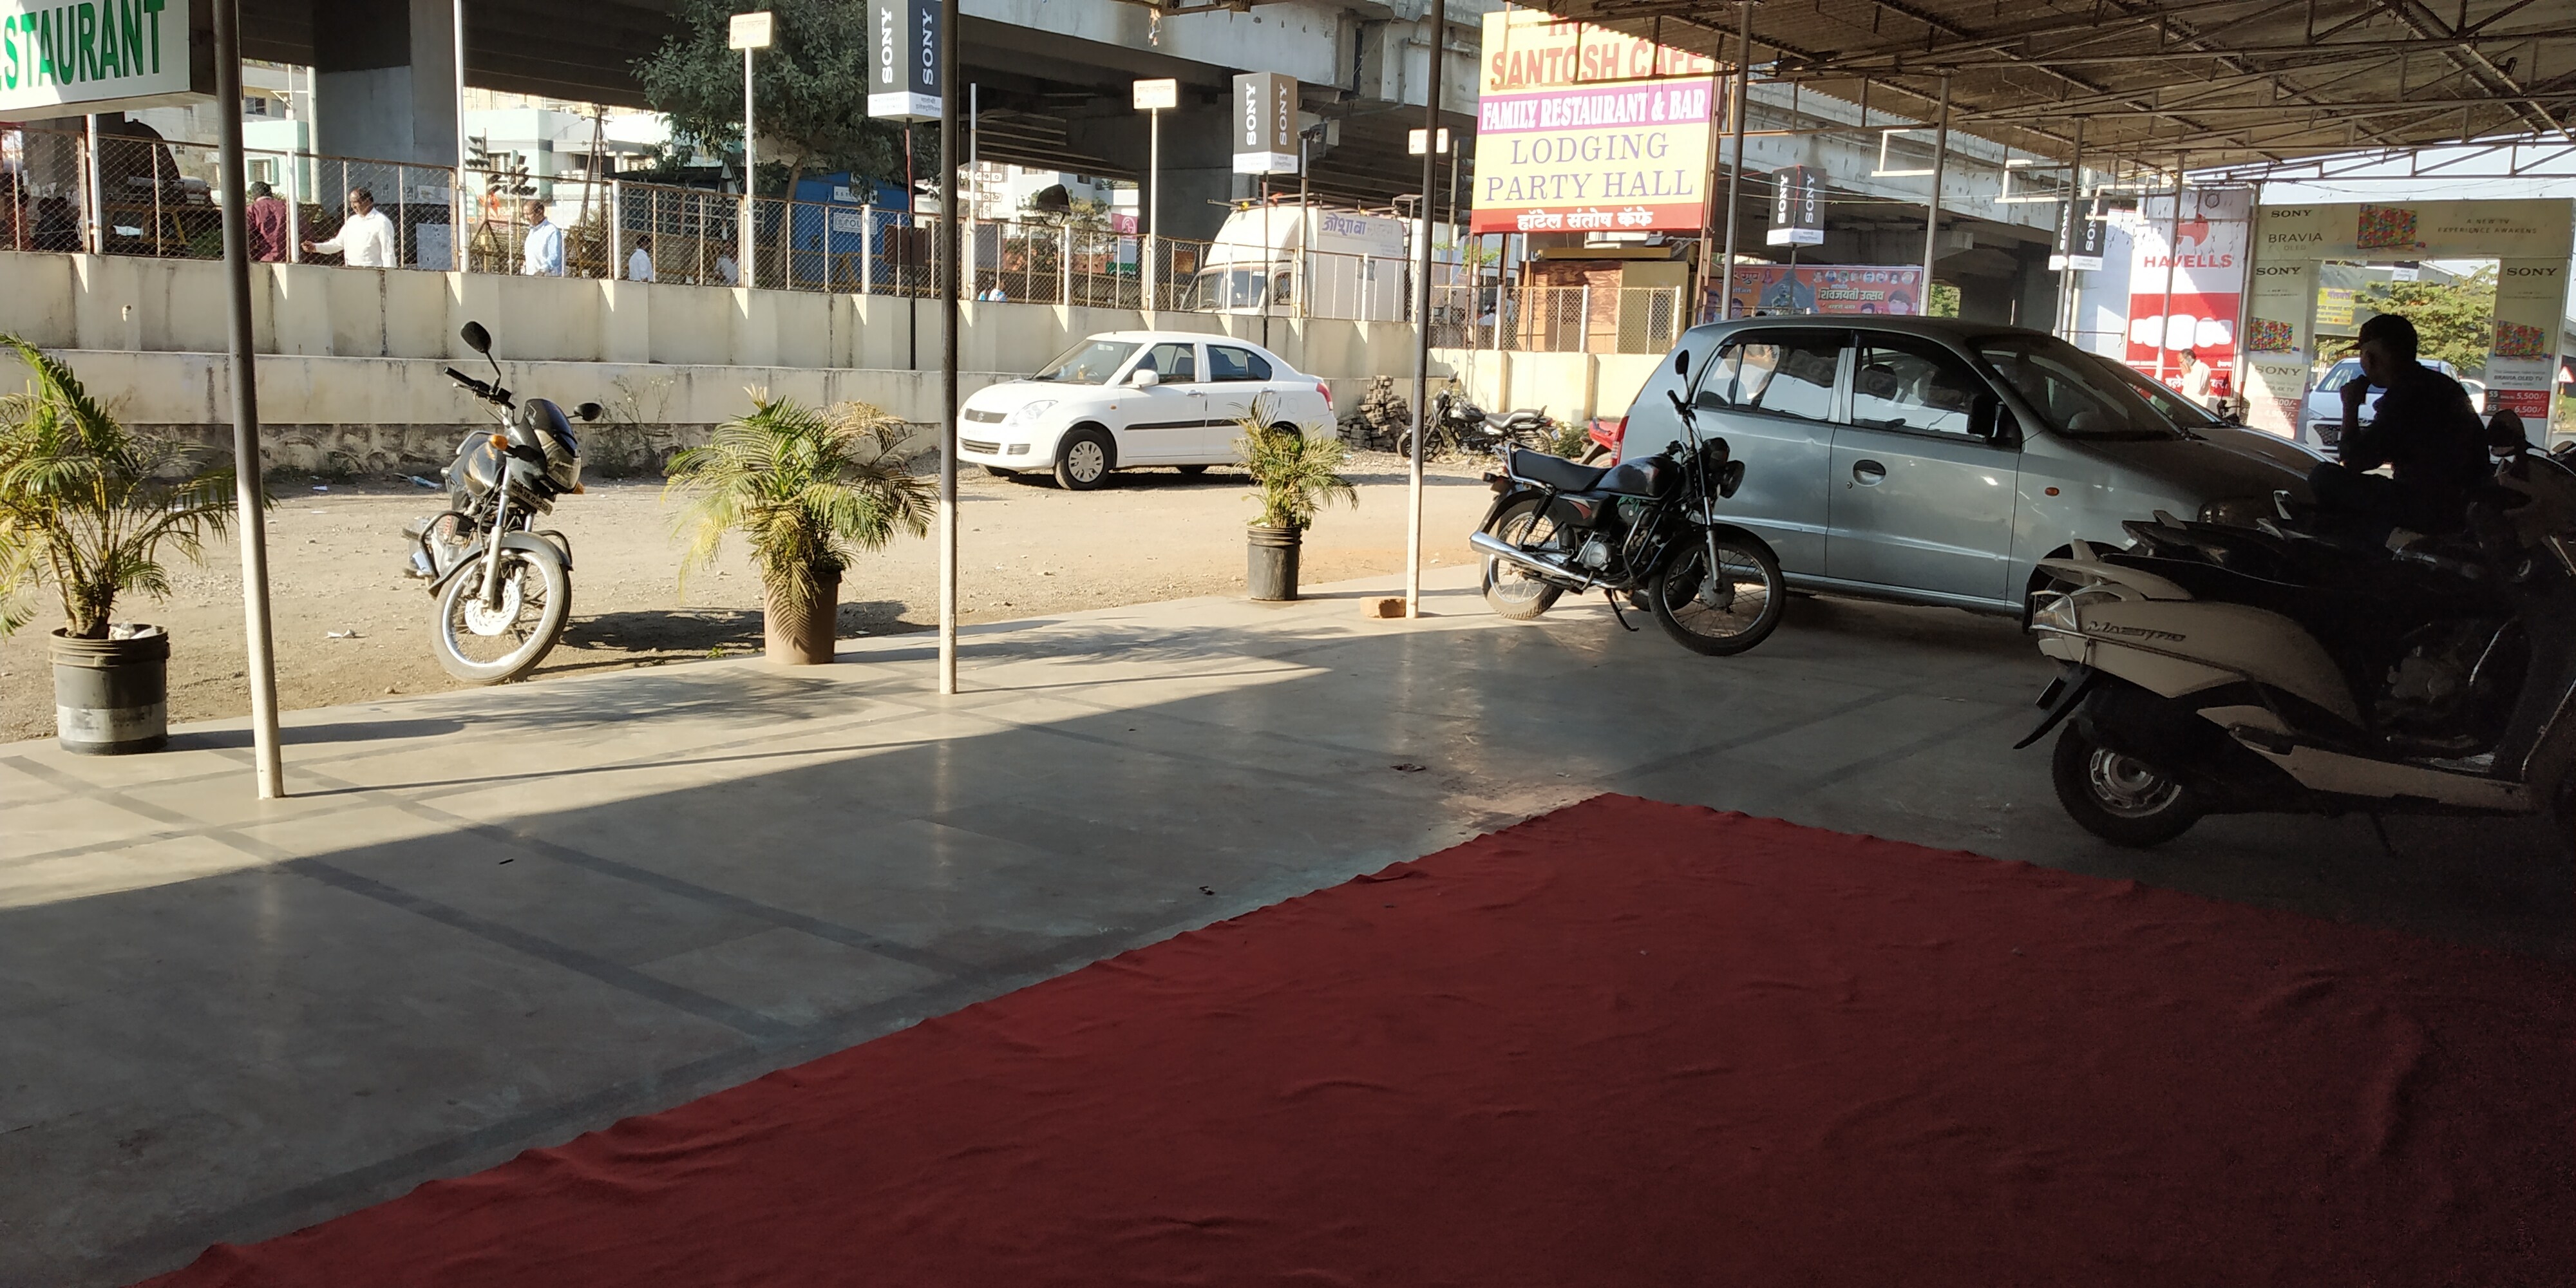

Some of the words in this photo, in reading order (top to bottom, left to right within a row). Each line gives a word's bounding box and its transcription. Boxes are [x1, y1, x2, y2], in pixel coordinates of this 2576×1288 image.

[0, 0, 166, 91] STAURANT
[881, 7, 893, 84] SONY
[922, 8, 933, 85] SONY
[1491, 43, 1620, 87] SANTOSH
[1246, 83, 1256, 146] SONY
[1481, 97, 1538, 131] FAMILY
[1540, 92, 1649, 128] RESTAURANT
[1651, 91, 1665, 122] &
[1669, 88, 1706, 120] BAR
[1510, 132, 1669, 165] LODGING
[1485, 173, 1593, 202] PARTY
[1602, 169, 1693, 198] HALL
[1778, 174, 1788, 224] SONY
[1805, 173, 1815, 223] SONY
[1517, 209, 1563, 231] हॉटेल
[1567, 207, 1613, 229] संतोष
[1617, 205, 1654, 227] कॅफे
[2268, 232, 2323, 243] BRAVIA
[2143, 254, 2233, 268] HAVELLS
[2256, 267, 2302, 276] SONY
[2507, 268, 2557, 276] SONY
[1818, 287, 1859, 301] शिवजयंती
[1861, 290, 1884, 301] उत्सव
[2255, 365, 2302, 375] SONY
[2517, 392, 2546, 401] 5,500/-
